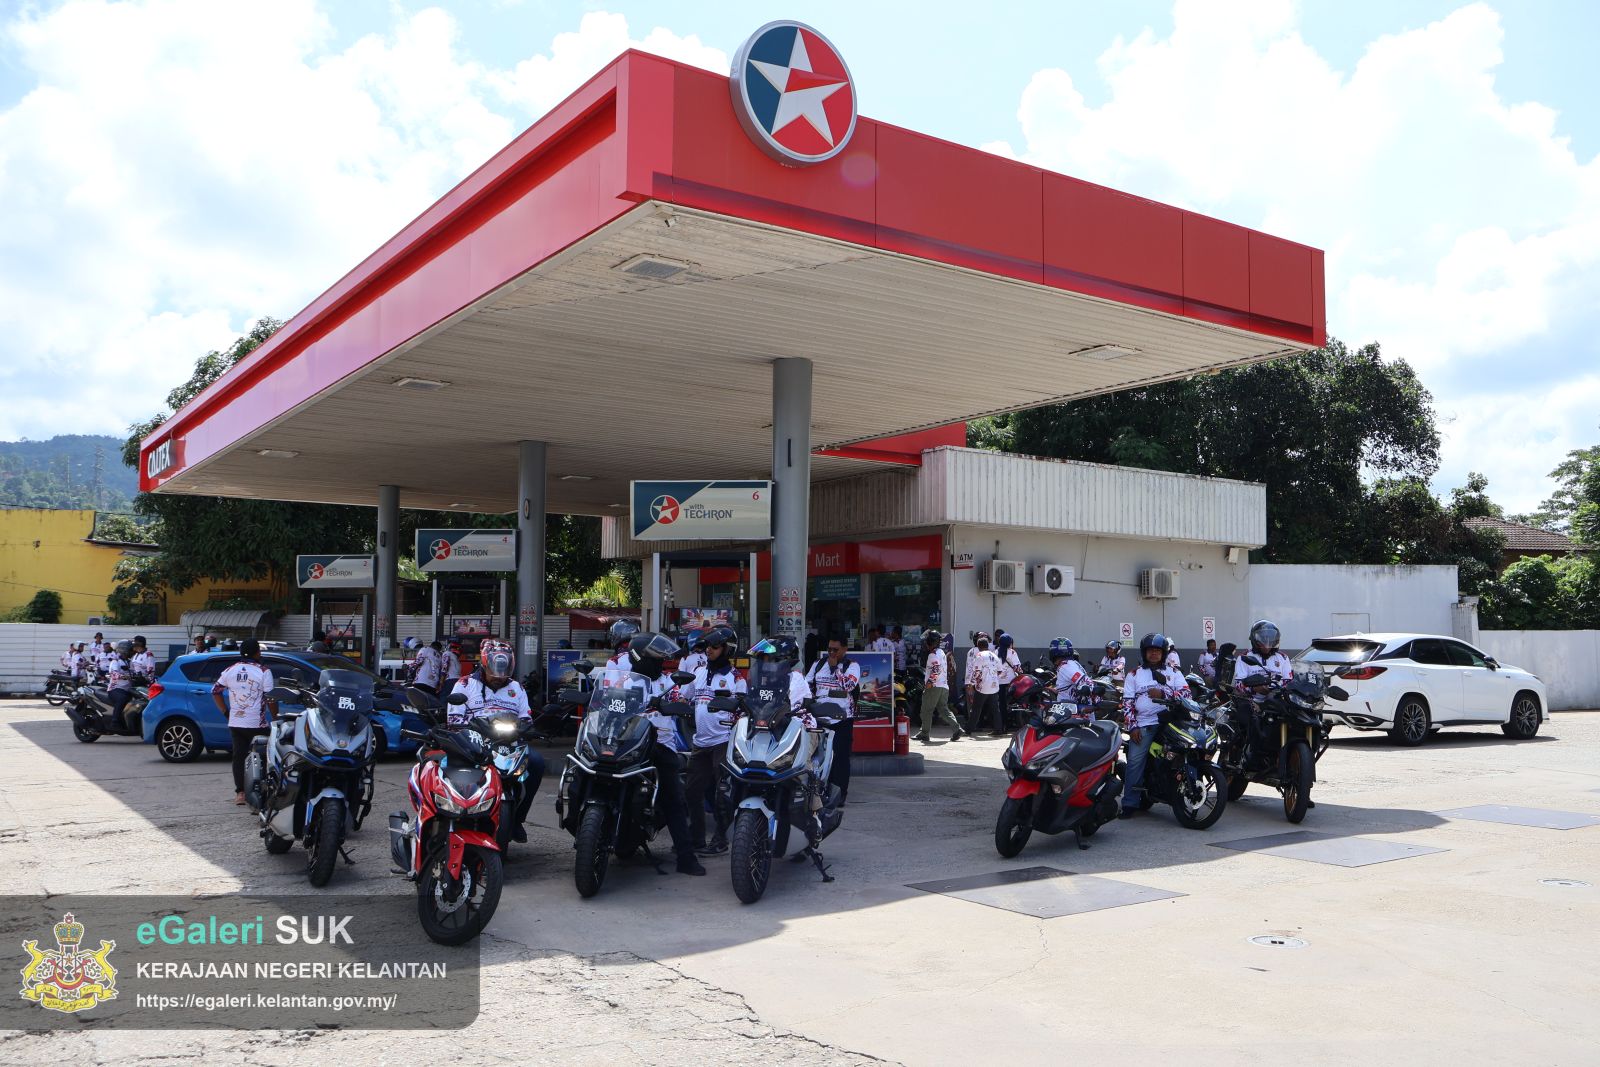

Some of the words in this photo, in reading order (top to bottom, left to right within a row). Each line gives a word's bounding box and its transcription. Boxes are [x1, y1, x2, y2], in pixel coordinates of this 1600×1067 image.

[148, 438, 170, 479] CALTEX
[752, 490, 760, 501] 6
[683, 508, 733, 521] TECHRON
[453, 549, 489, 558] TECHRON
[959, 553, 974, 561] ATM
[815, 552, 840, 568] Mart
[326, 570, 353, 578] TECHRON
[611, 698, 626, 708] VRA
